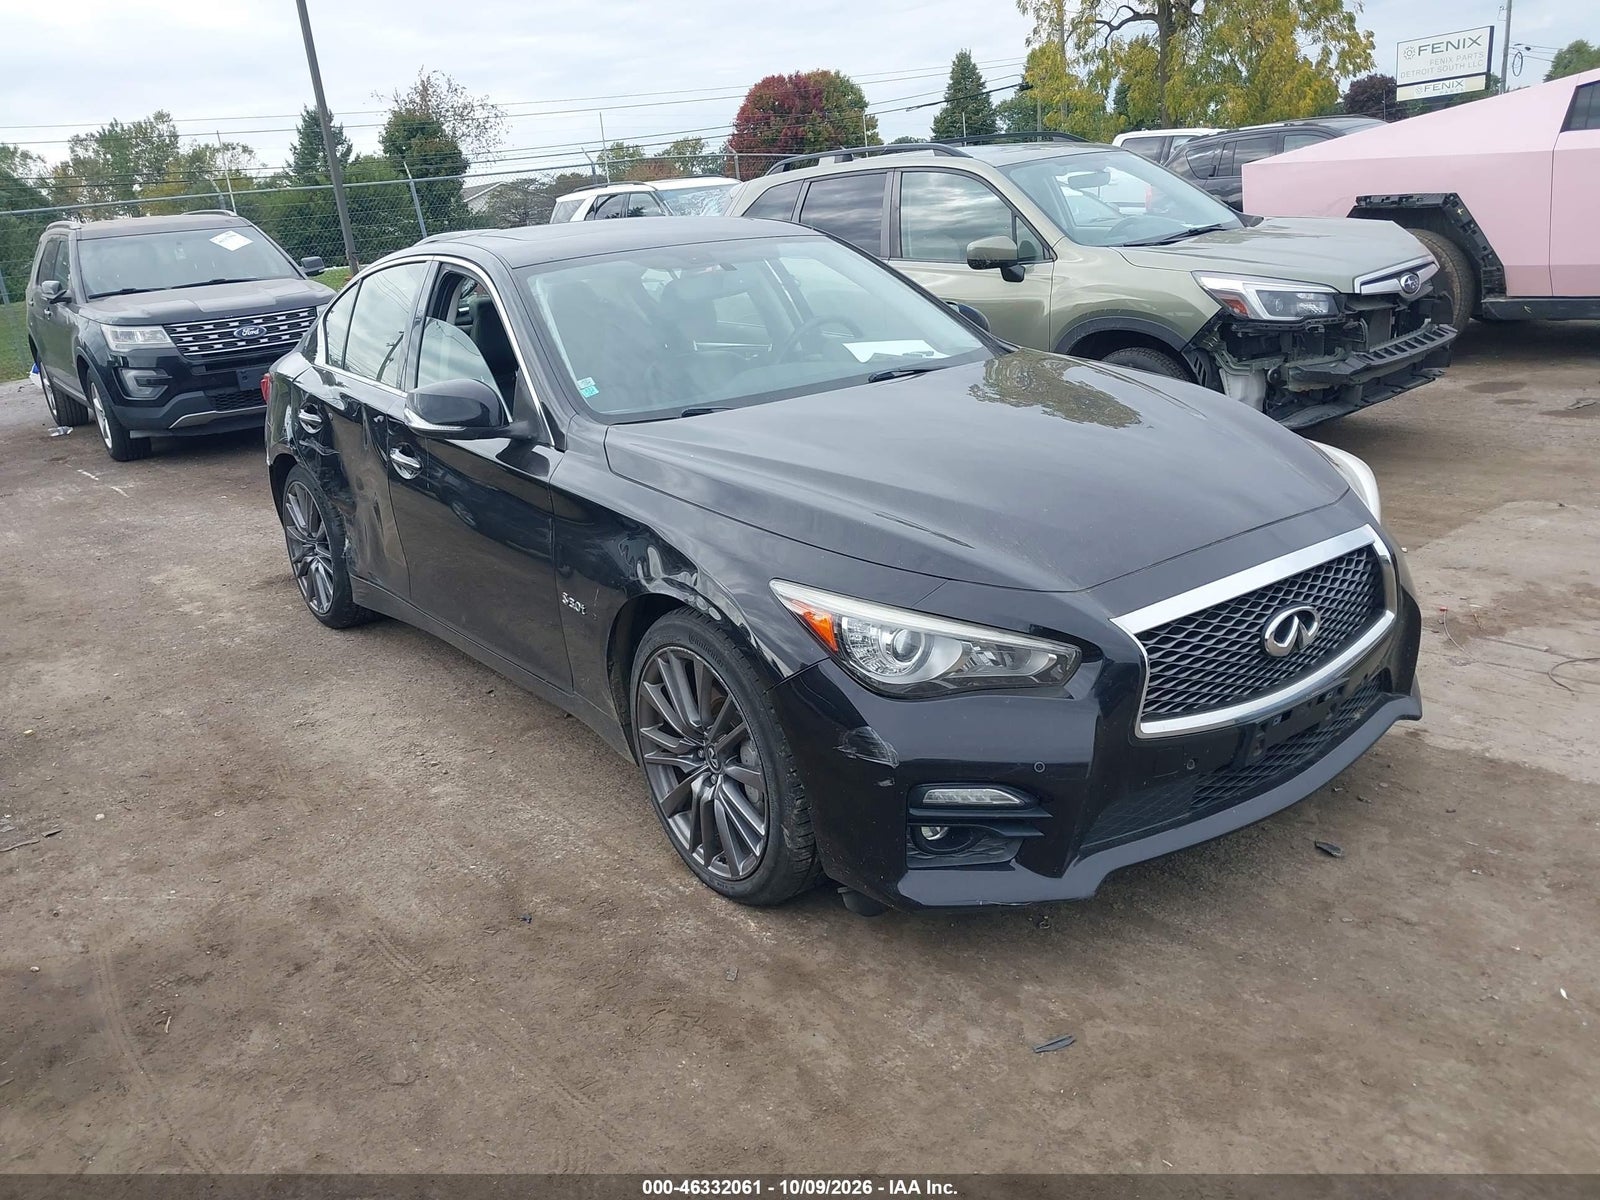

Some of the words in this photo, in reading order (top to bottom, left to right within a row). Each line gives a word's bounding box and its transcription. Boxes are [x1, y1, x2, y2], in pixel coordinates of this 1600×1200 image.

[1418, 35, 1482, 56] FENIX
[1429, 57, 1453, 66] FENIX
[1457, 52, 1484, 61] PARTS
[1400, 67, 1434, 79] DETROIT
[1437, 63, 1465, 73] SOUTH
[1468, 60, 1484, 68] LLC
[1424, 79, 1464, 92] FENIX
[241, 327, 260, 336] Ford
